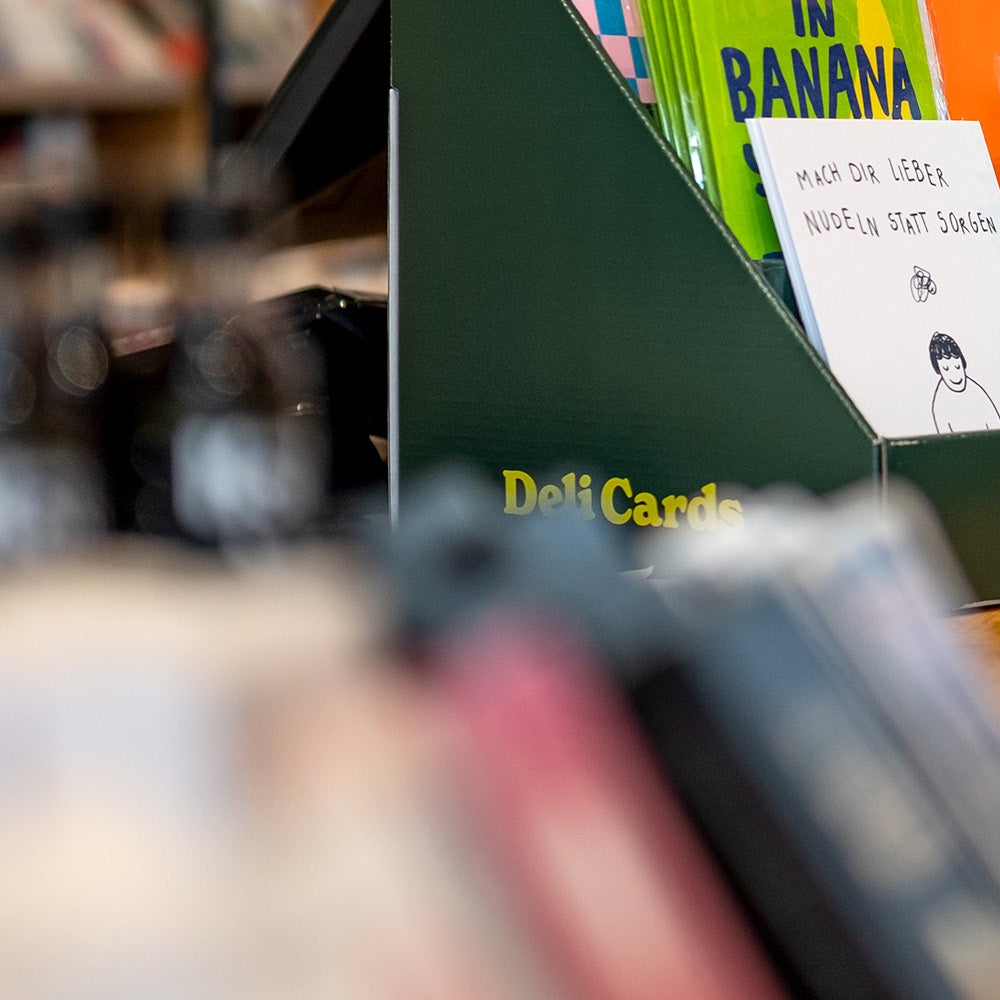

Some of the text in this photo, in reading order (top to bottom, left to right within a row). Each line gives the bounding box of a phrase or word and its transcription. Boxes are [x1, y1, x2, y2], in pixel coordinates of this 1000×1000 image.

[720, 42, 923, 123] BANANA
[796, 161, 842, 191] MACH
[848, 162, 881, 185] DIR
[888, 157, 950, 188] LIEBER
[803, 207, 998, 238] NUDELN STATT SORGEN
[600, 476, 745, 531] Cards
